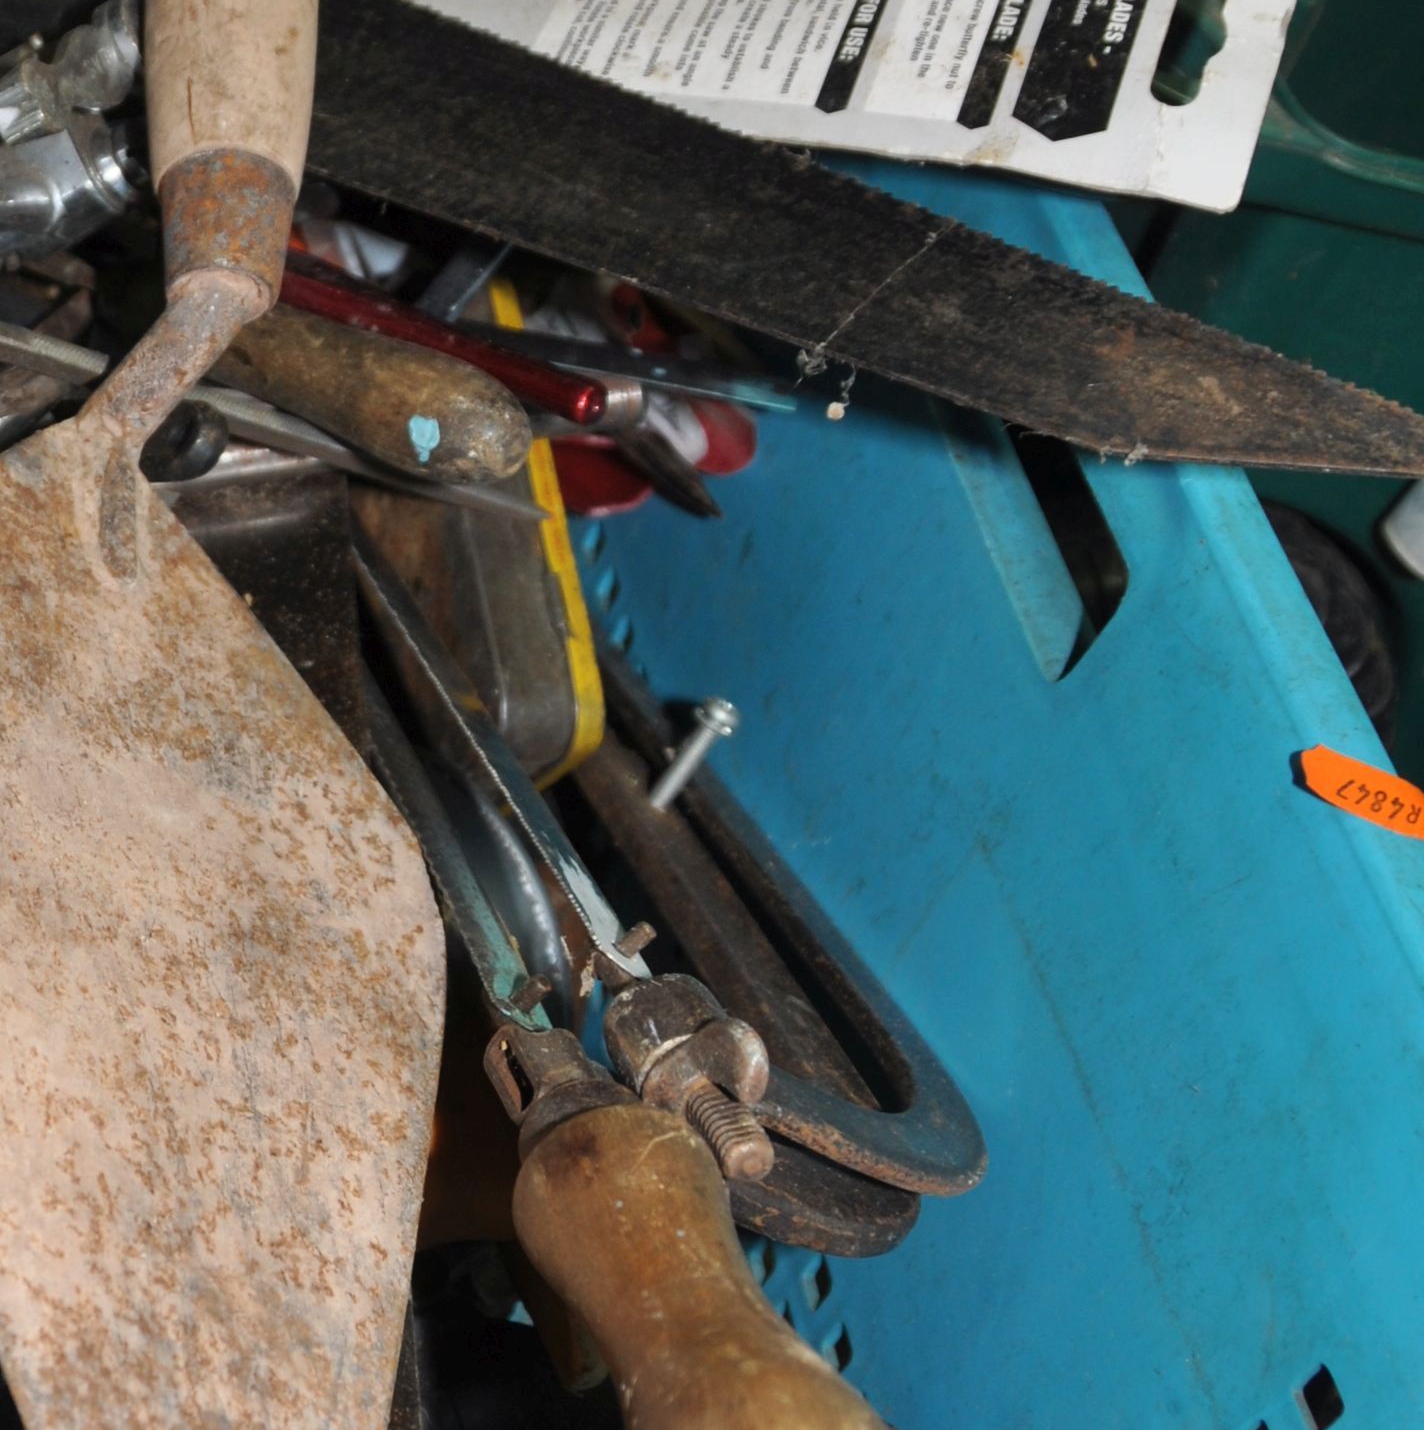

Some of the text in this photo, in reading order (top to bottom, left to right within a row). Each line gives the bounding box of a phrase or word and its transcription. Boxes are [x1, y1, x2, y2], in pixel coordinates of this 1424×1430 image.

[926, 0, 941, 15] and
[933, 14, 947, 31] new
[837, 26, 869, 62] USE:
[926, 34, 940, 49] one
[952, 23, 977, 60] butterfly
[922, 52, 935, 61] in
[916, 64, 931, 77] the
[948, 63, 961, 78] nut
[944, 80, 955, 89] to
